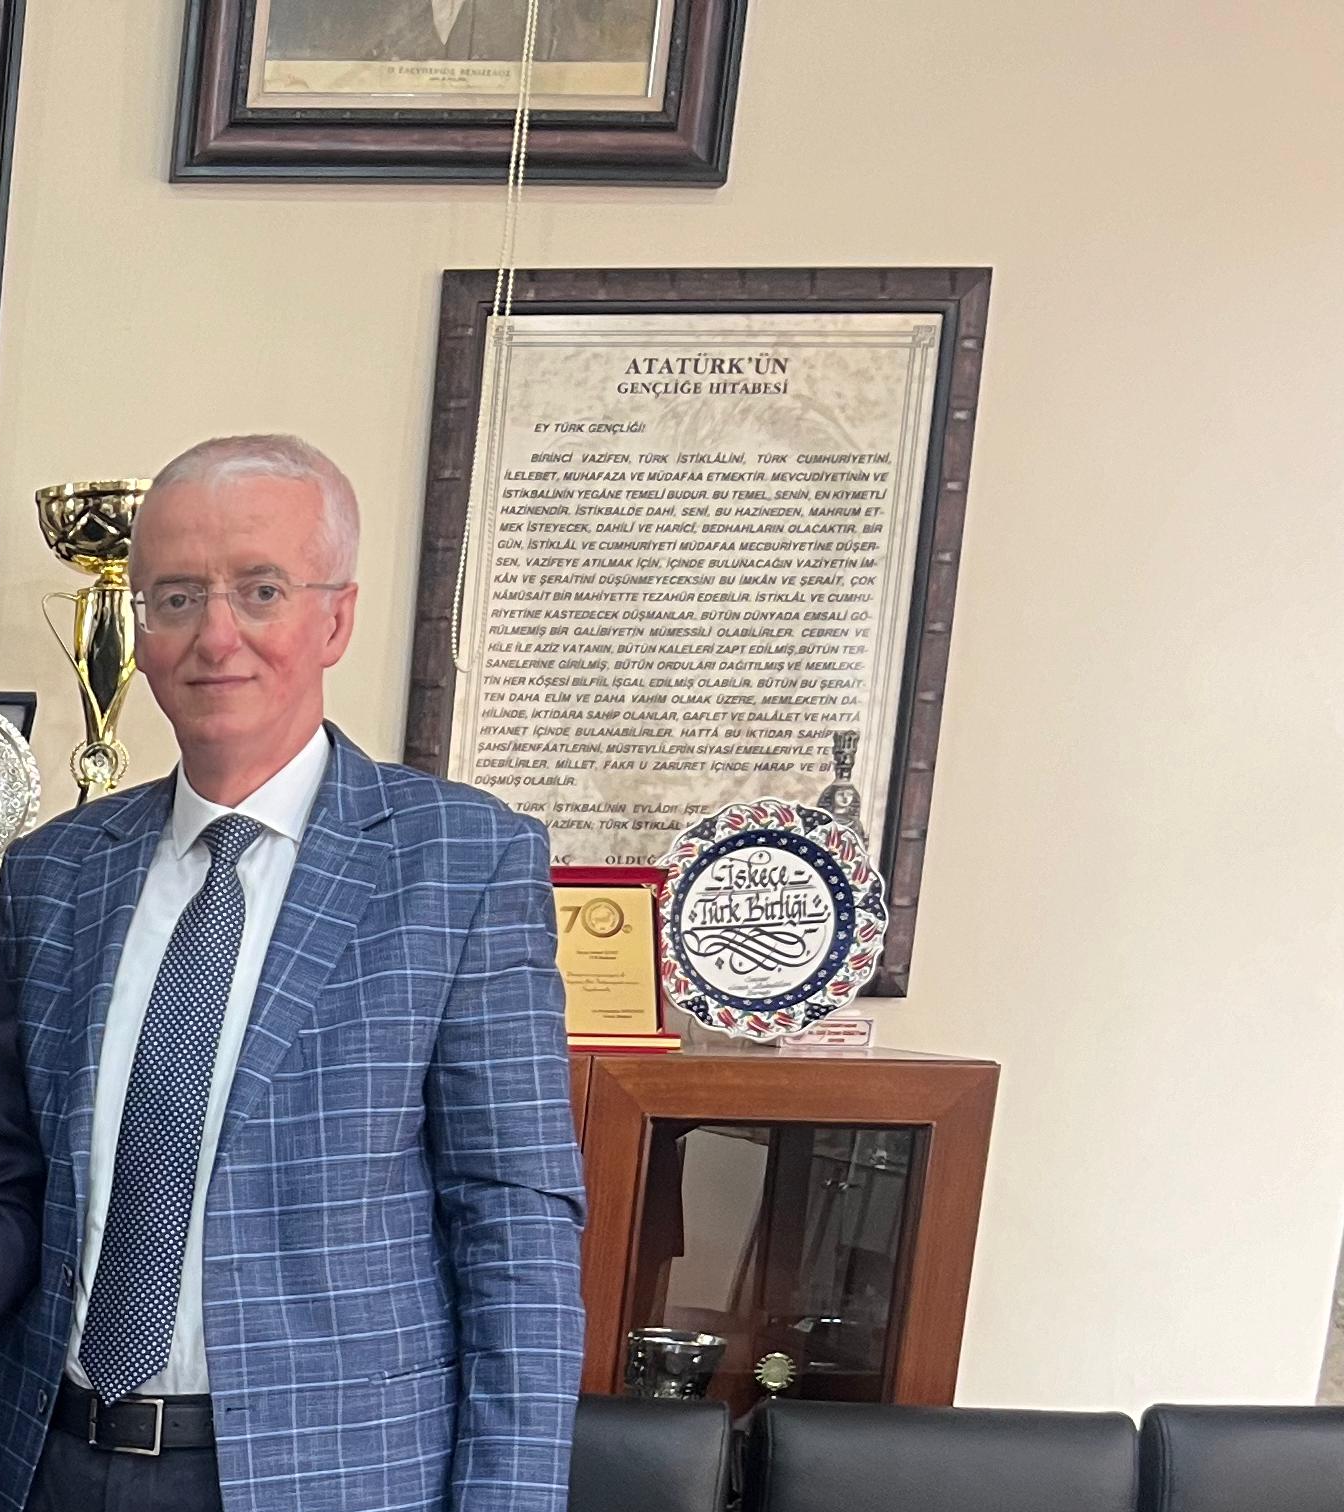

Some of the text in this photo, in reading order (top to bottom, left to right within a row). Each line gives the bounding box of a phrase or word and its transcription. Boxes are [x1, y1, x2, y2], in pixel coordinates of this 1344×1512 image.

[624, 352, 790, 375] ATATÜRK'ÜN
[617, 379, 789, 399] GENÇLİĞE HİTABESİ
[533, 423, 551, 433] EY
[553, 422, 585, 433] TÜRK
[530, 452, 574, 464] BİRİNCİ
[637, 453, 670, 464] TÜRK
[756, 453, 788, 464] TÜRK
[562, 471, 627, 482] MUHAFAZA
[630, 471, 646, 482] VE
[646, 470, 704, 482] MÜDAFAA
[873, 472, 889, 482] VE
[712, 490, 729, 500] BU
[814, 490, 830, 500] EN
[714, 506, 732, 516] BU
[808, 506, 862, 517] MAHRUM
[499, 522, 525, 533] MEK
[637, 523, 653, 533] VE
[581, 541, 597, 550] VE
[679, 540, 736, 551] MÜDAFAA
[694, 888, 809, 925] Türk Birliği
